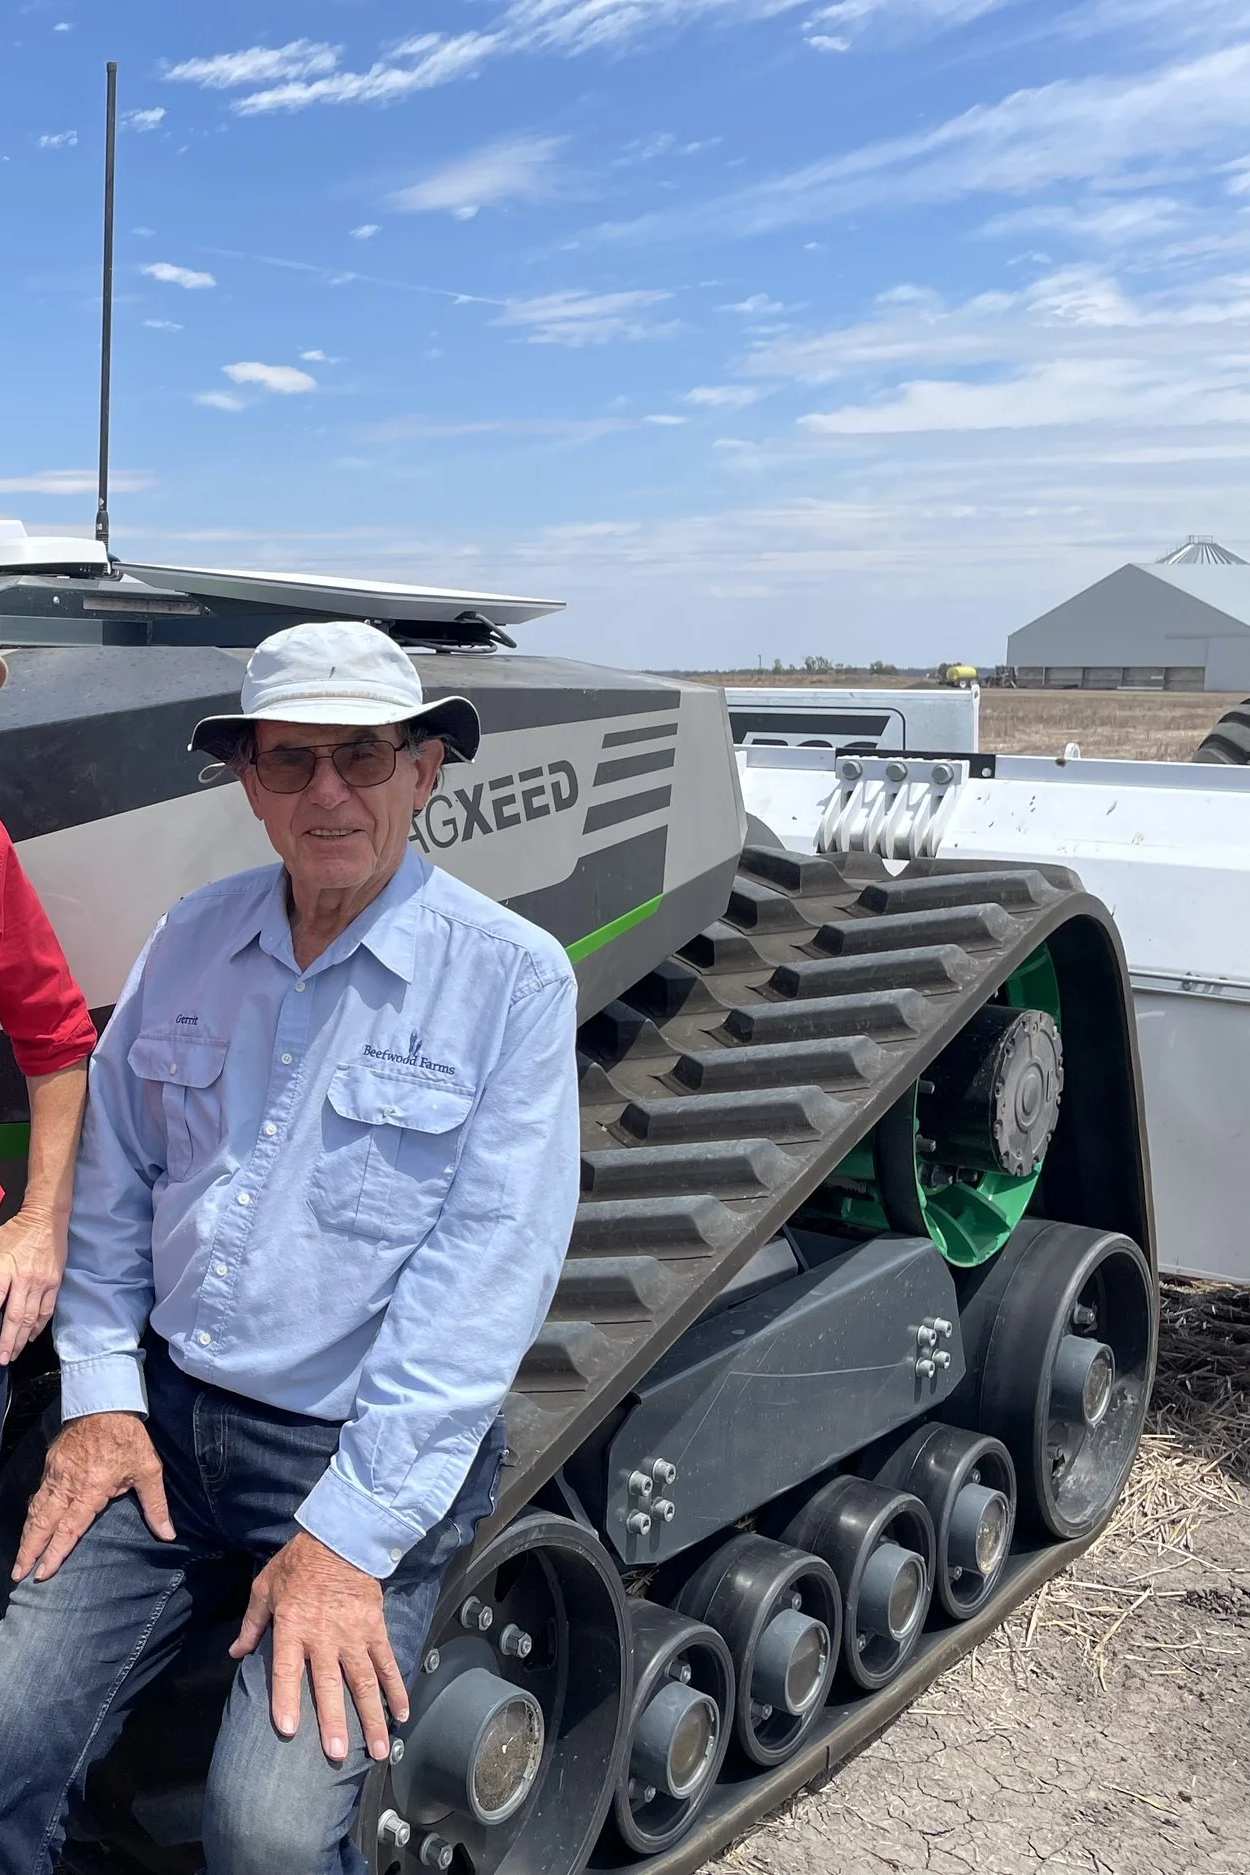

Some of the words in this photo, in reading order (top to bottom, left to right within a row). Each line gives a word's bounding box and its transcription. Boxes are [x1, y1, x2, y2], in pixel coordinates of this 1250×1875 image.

[175, 1013, 198, 1025] Gerrit
[363, 1044, 418, 1066] Beefwood
[419, 1056, 455, 1075] Farms
